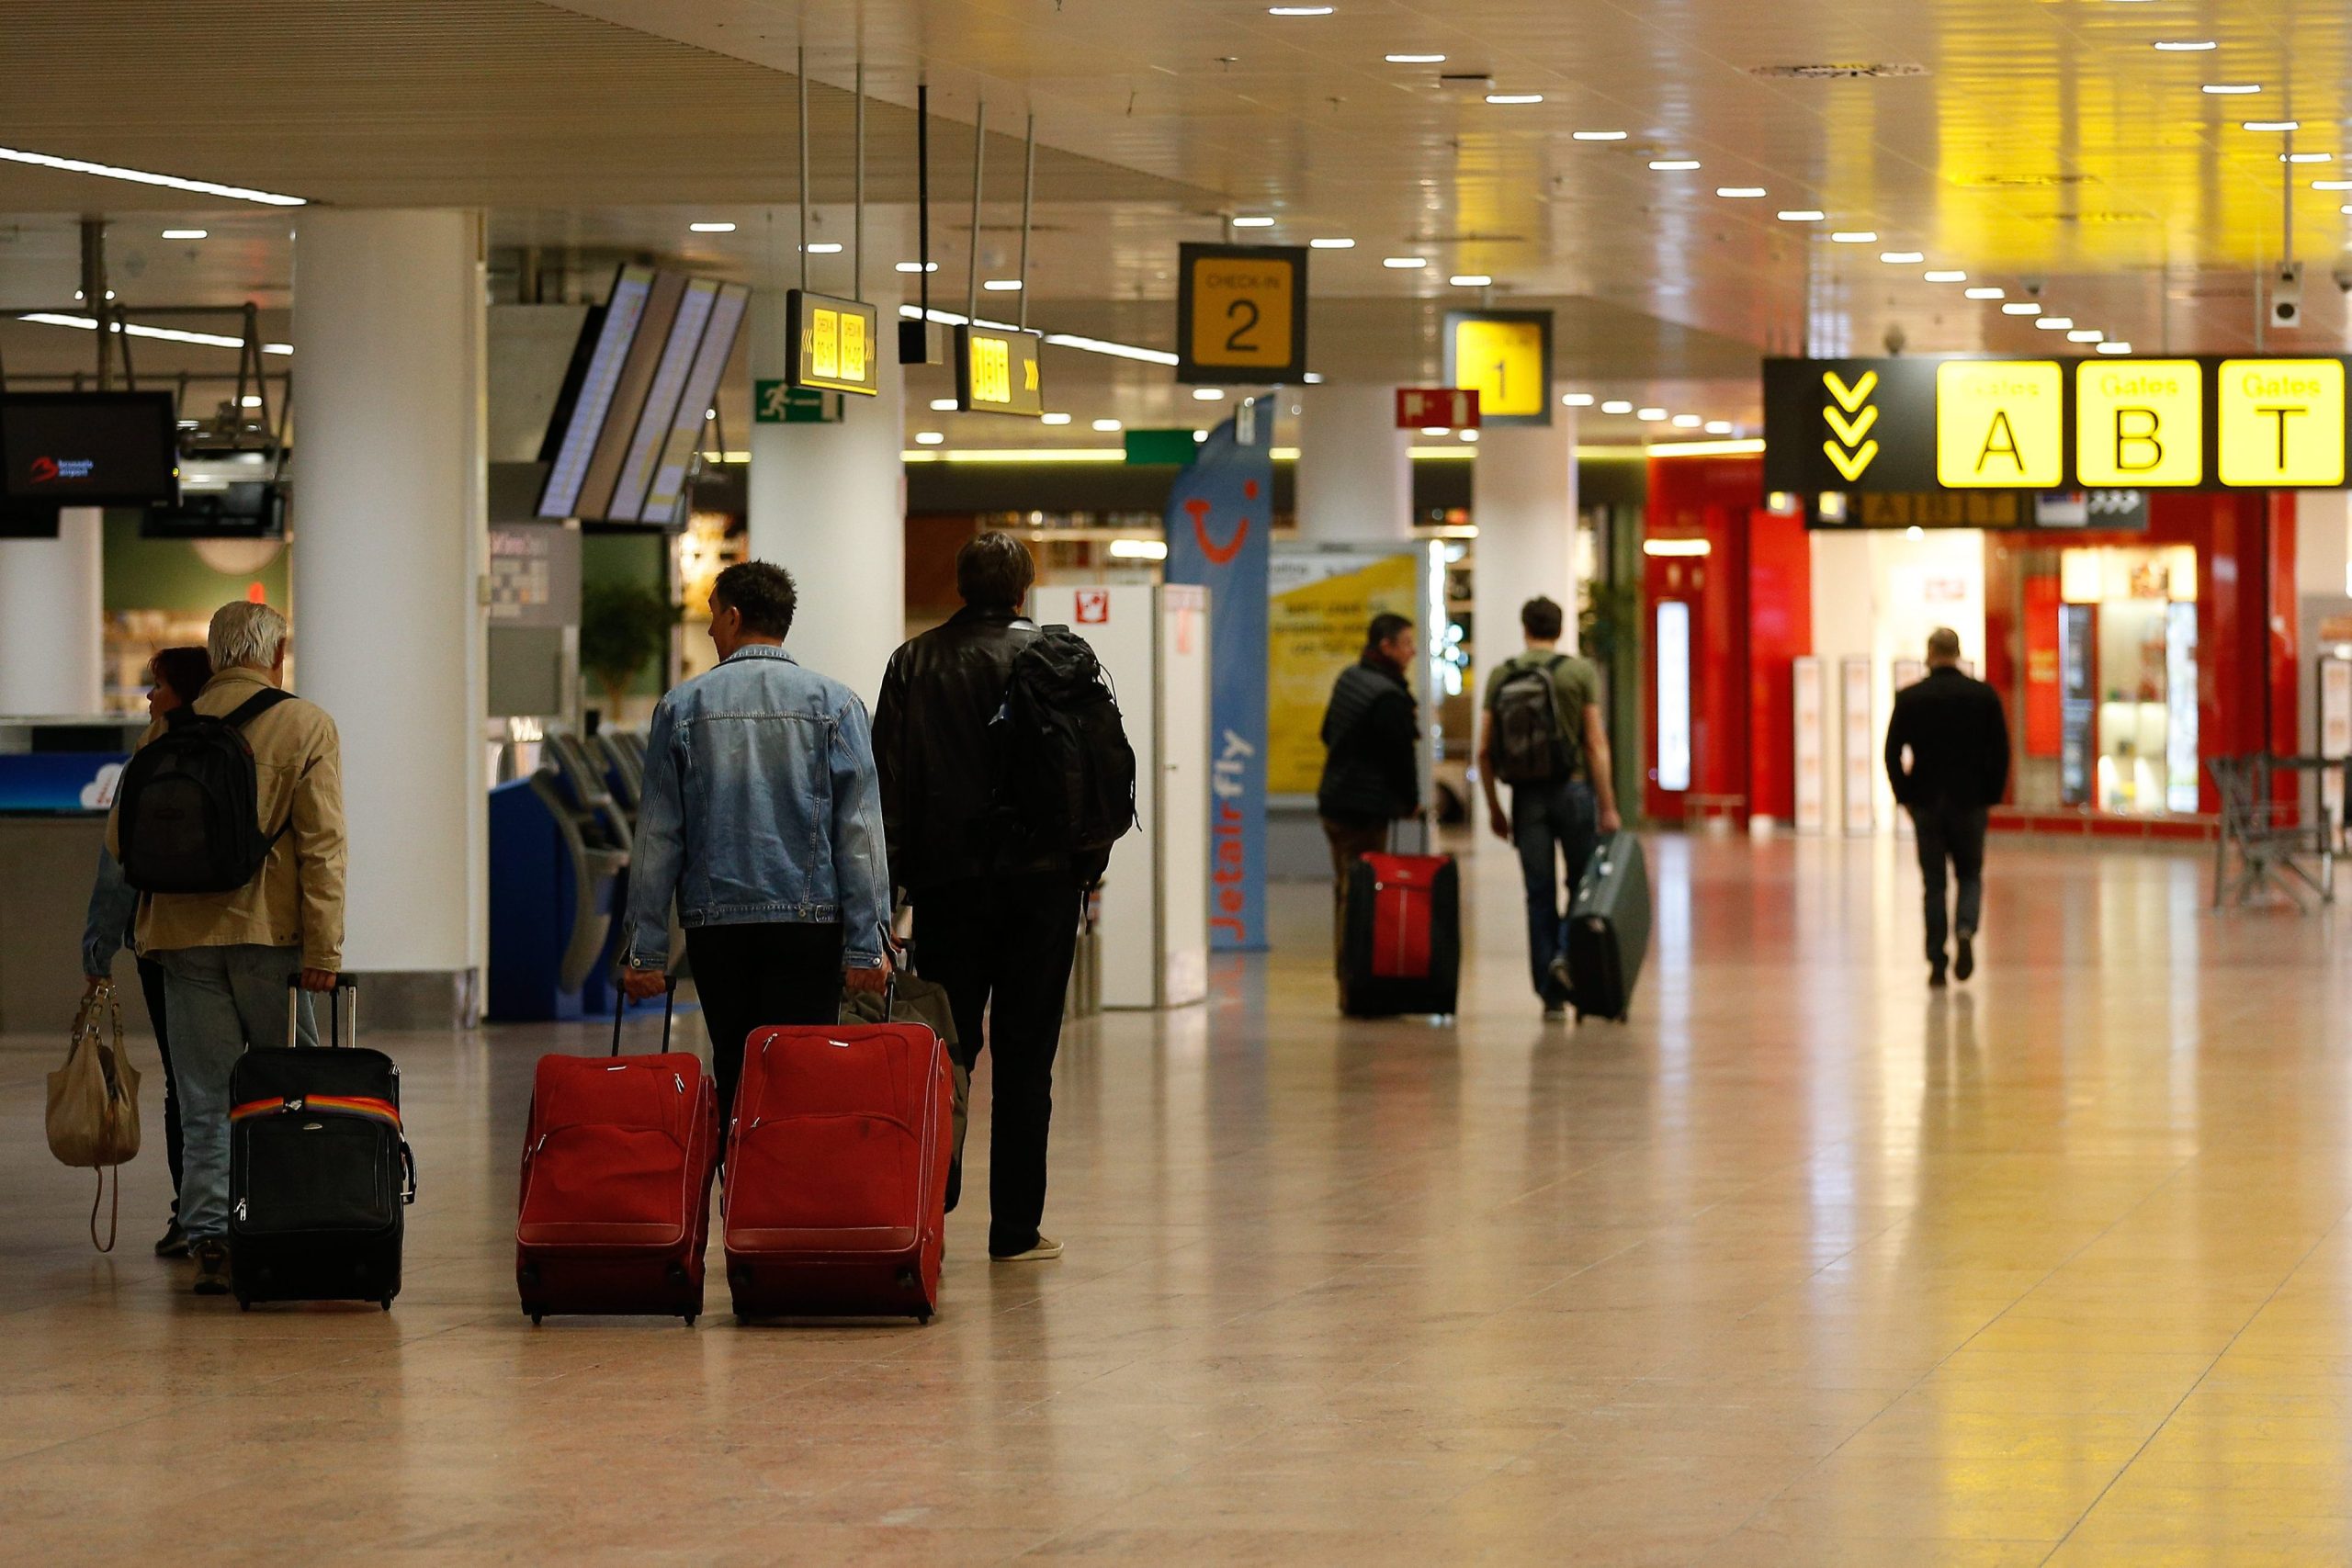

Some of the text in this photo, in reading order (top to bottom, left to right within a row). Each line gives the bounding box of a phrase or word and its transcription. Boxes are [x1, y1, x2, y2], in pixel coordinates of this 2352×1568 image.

[1226, 298, 1259, 352] 2
[1492, 357, 1507, 401] 1
[2100, 373, 2179, 397] Gates
[2243, 371, 2322, 399] Gates
[1976, 407, 2308, 473] A B T
